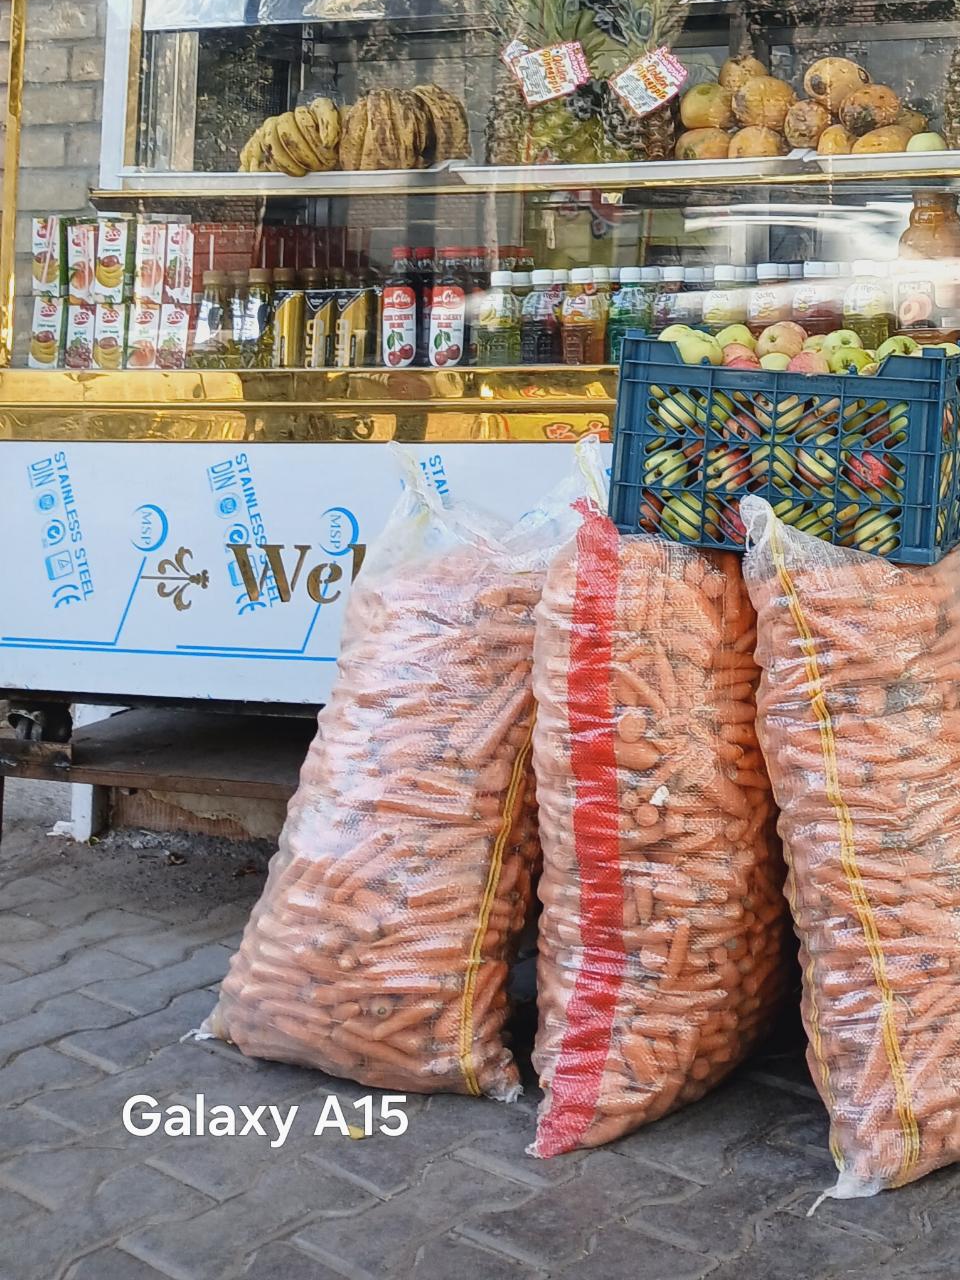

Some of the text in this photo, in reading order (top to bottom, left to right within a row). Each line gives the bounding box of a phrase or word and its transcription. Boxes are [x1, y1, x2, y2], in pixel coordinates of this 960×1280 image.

[30, 458, 56, 487] DIN
[210, 462, 237, 491] DIN
[53, 451, 94, 601] STAINLESS STEEL
[139, 510, 153, 550] MSP
[329, 514, 342, 551] MSP
